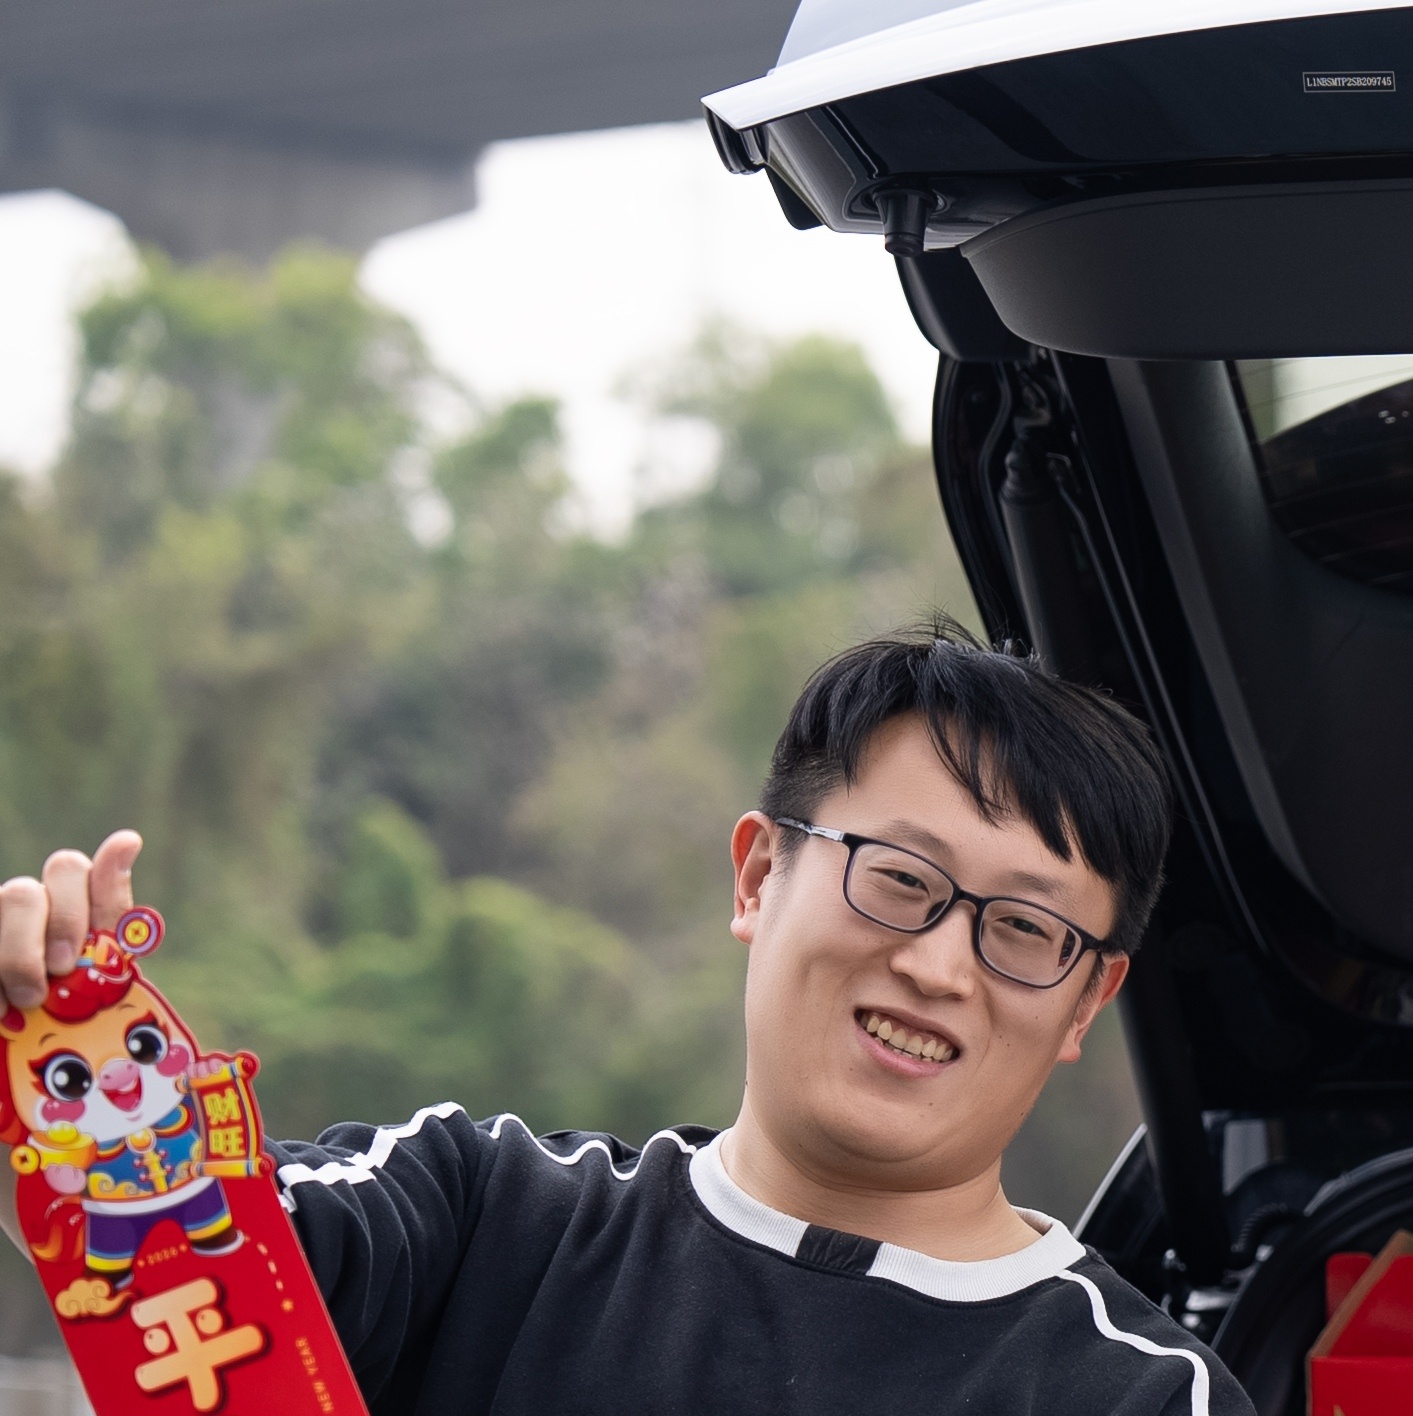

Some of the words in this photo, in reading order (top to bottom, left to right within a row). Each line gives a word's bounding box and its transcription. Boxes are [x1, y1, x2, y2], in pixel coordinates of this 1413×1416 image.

[203, 1087, 246, 1157] 财旺
[295, 1337, 319, 1375] YEAR
[313, 1380, 334, 1413] NEW
